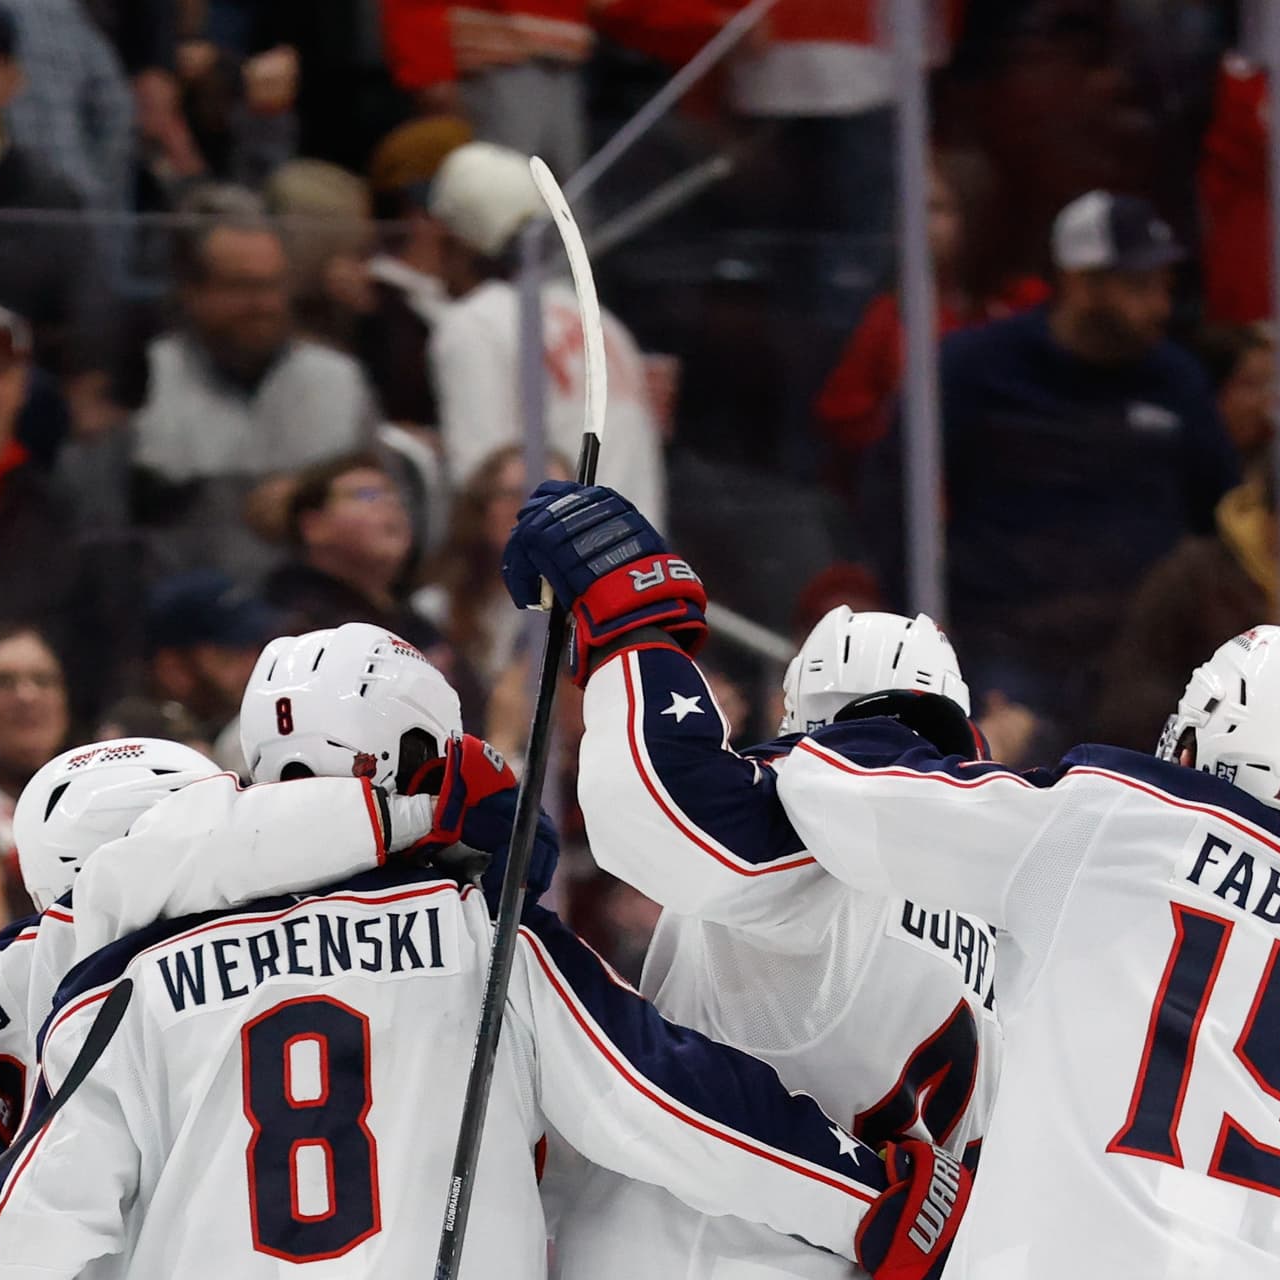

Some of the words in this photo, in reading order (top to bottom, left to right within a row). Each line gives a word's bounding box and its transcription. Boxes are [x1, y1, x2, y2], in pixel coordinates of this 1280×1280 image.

[276, 697, 294, 736] 8
[156, 907, 445, 1013] WERENSKI
[240, 994, 383, 1265] 8
[446, 1176, 463, 1232] GUDBRANSON
